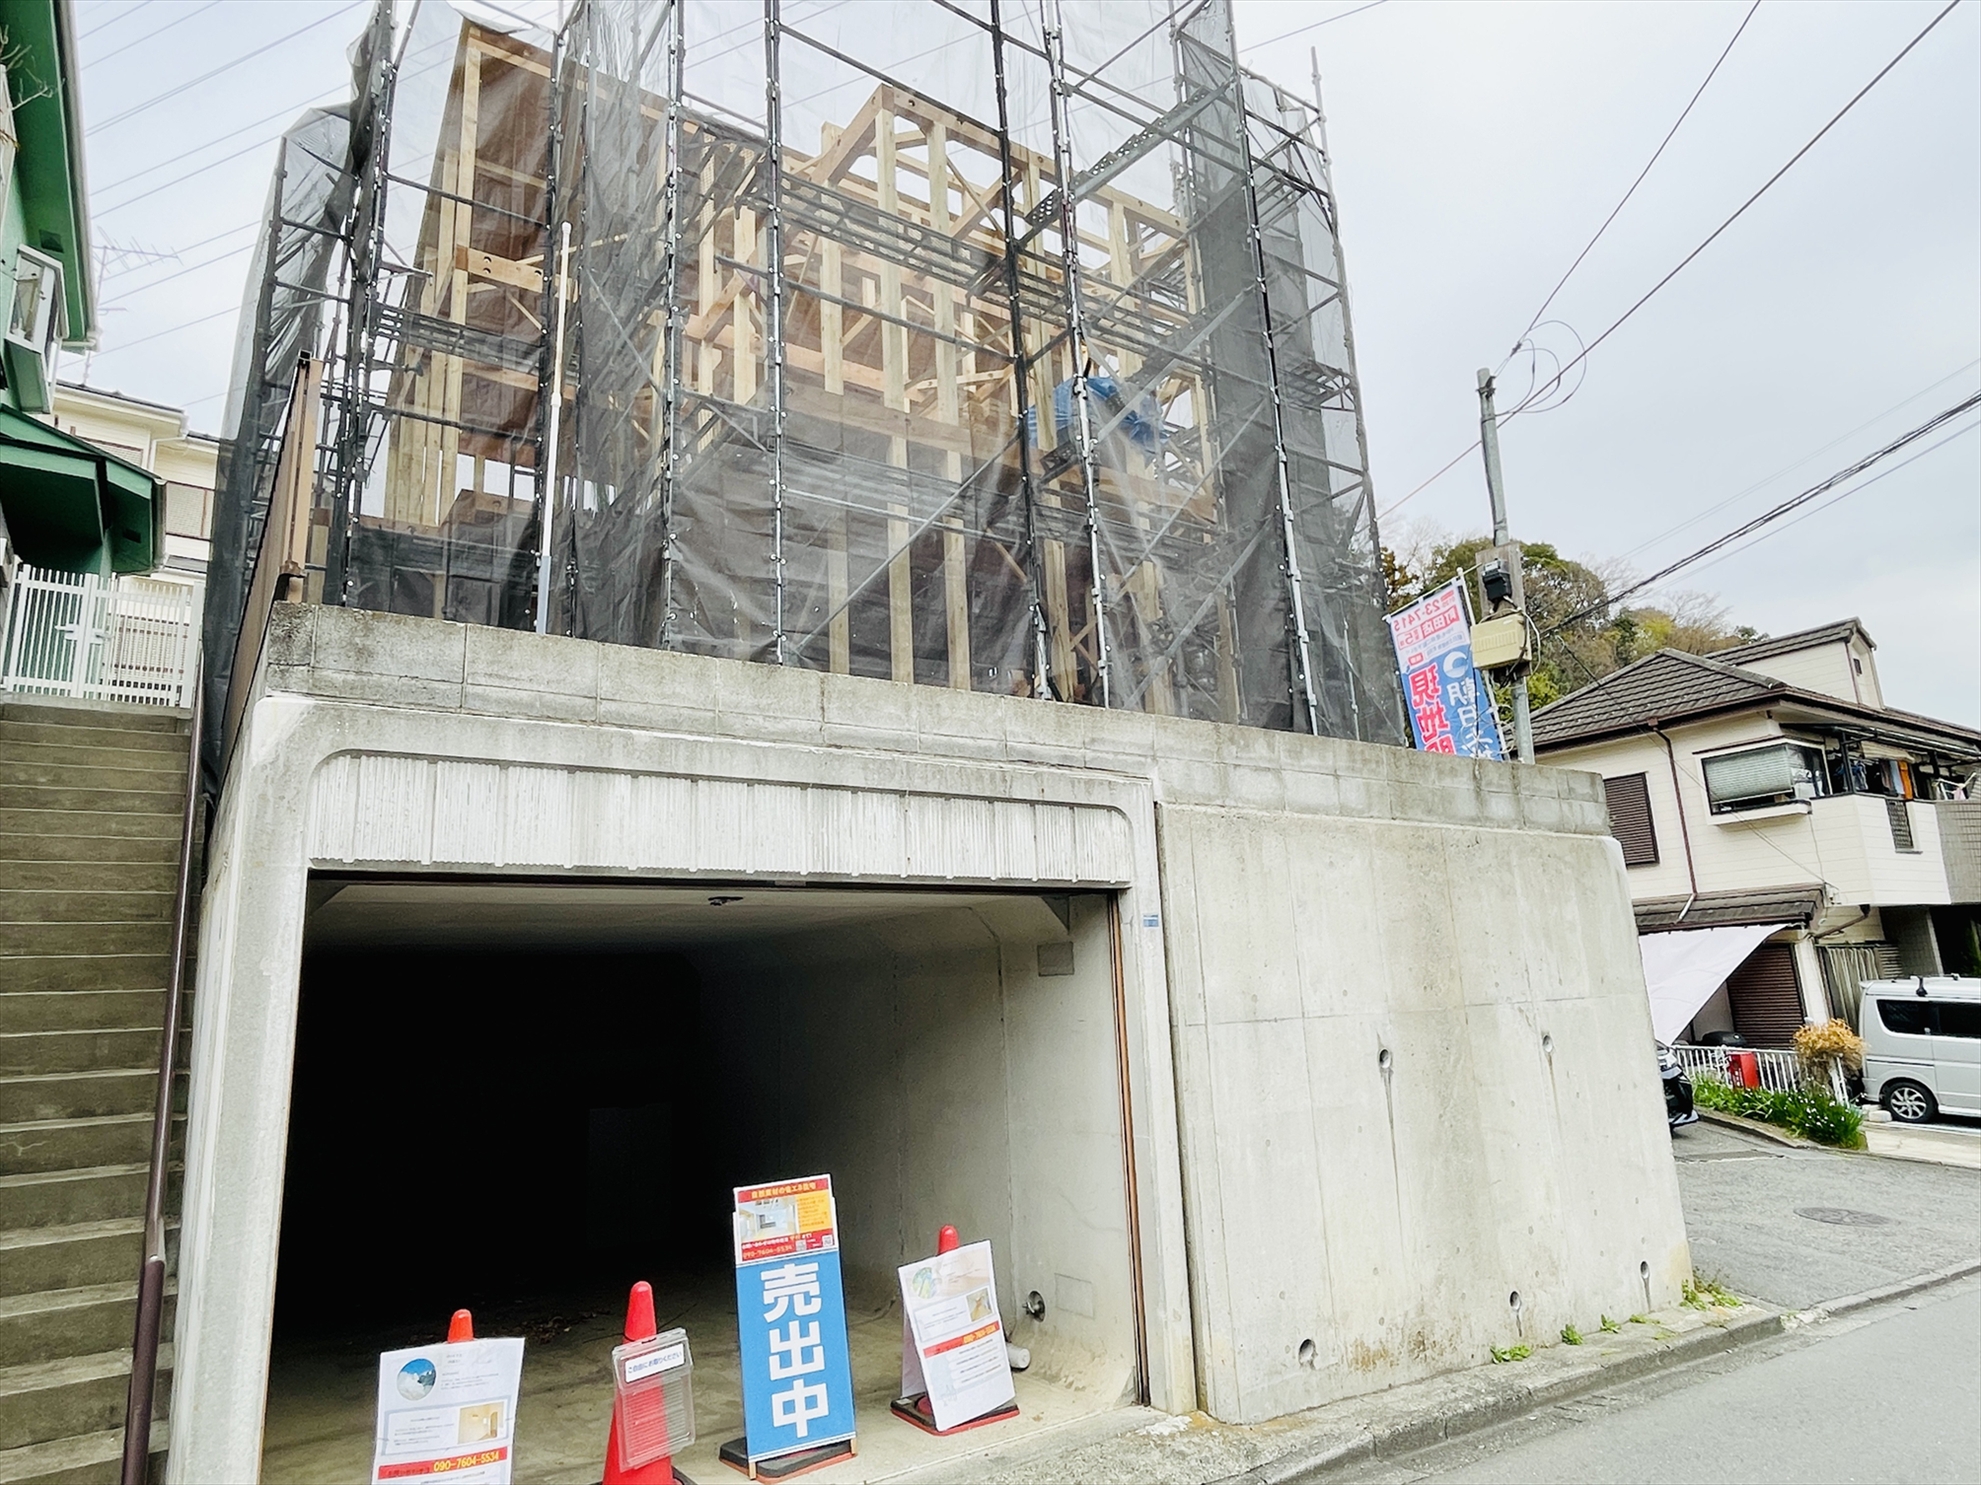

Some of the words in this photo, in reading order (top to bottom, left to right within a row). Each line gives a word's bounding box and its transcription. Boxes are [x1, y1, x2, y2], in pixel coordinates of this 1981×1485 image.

[761, 1262, 830, 1438] 売出中
[433, 1451, 500, 1472] 090-7604-5534
